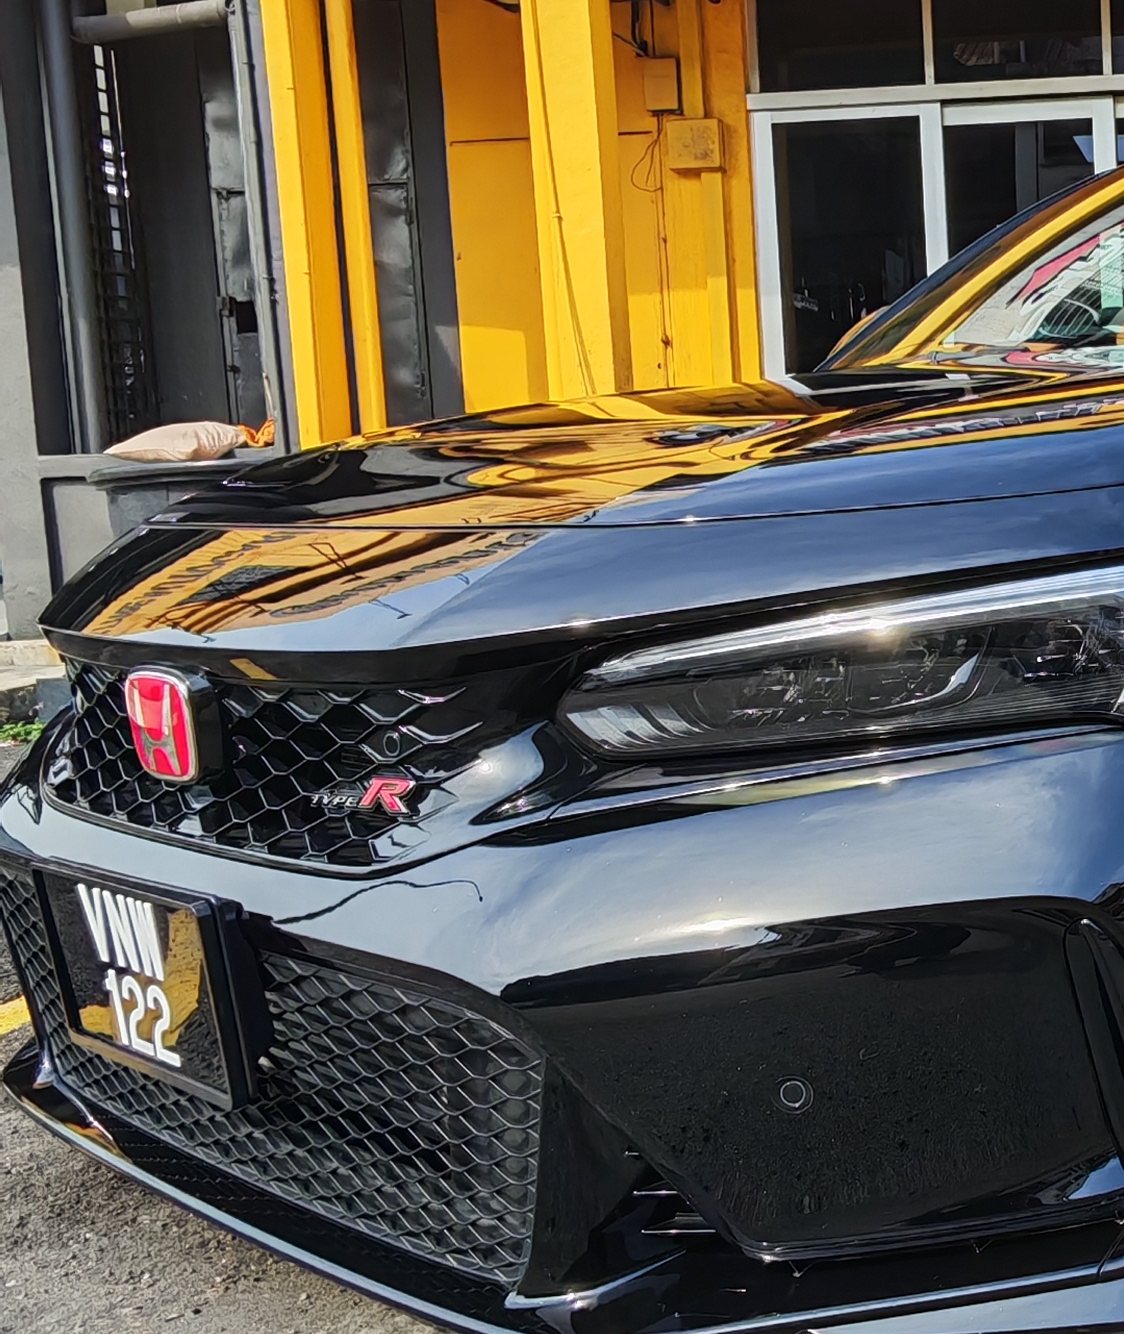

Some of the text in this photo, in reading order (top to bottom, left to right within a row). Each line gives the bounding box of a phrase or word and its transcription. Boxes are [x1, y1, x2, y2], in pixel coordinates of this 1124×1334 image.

[310, 775, 417, 815] TYPE R
[77, 883, 165, 982] VNW
[105, 969, 182, 1068] 122
